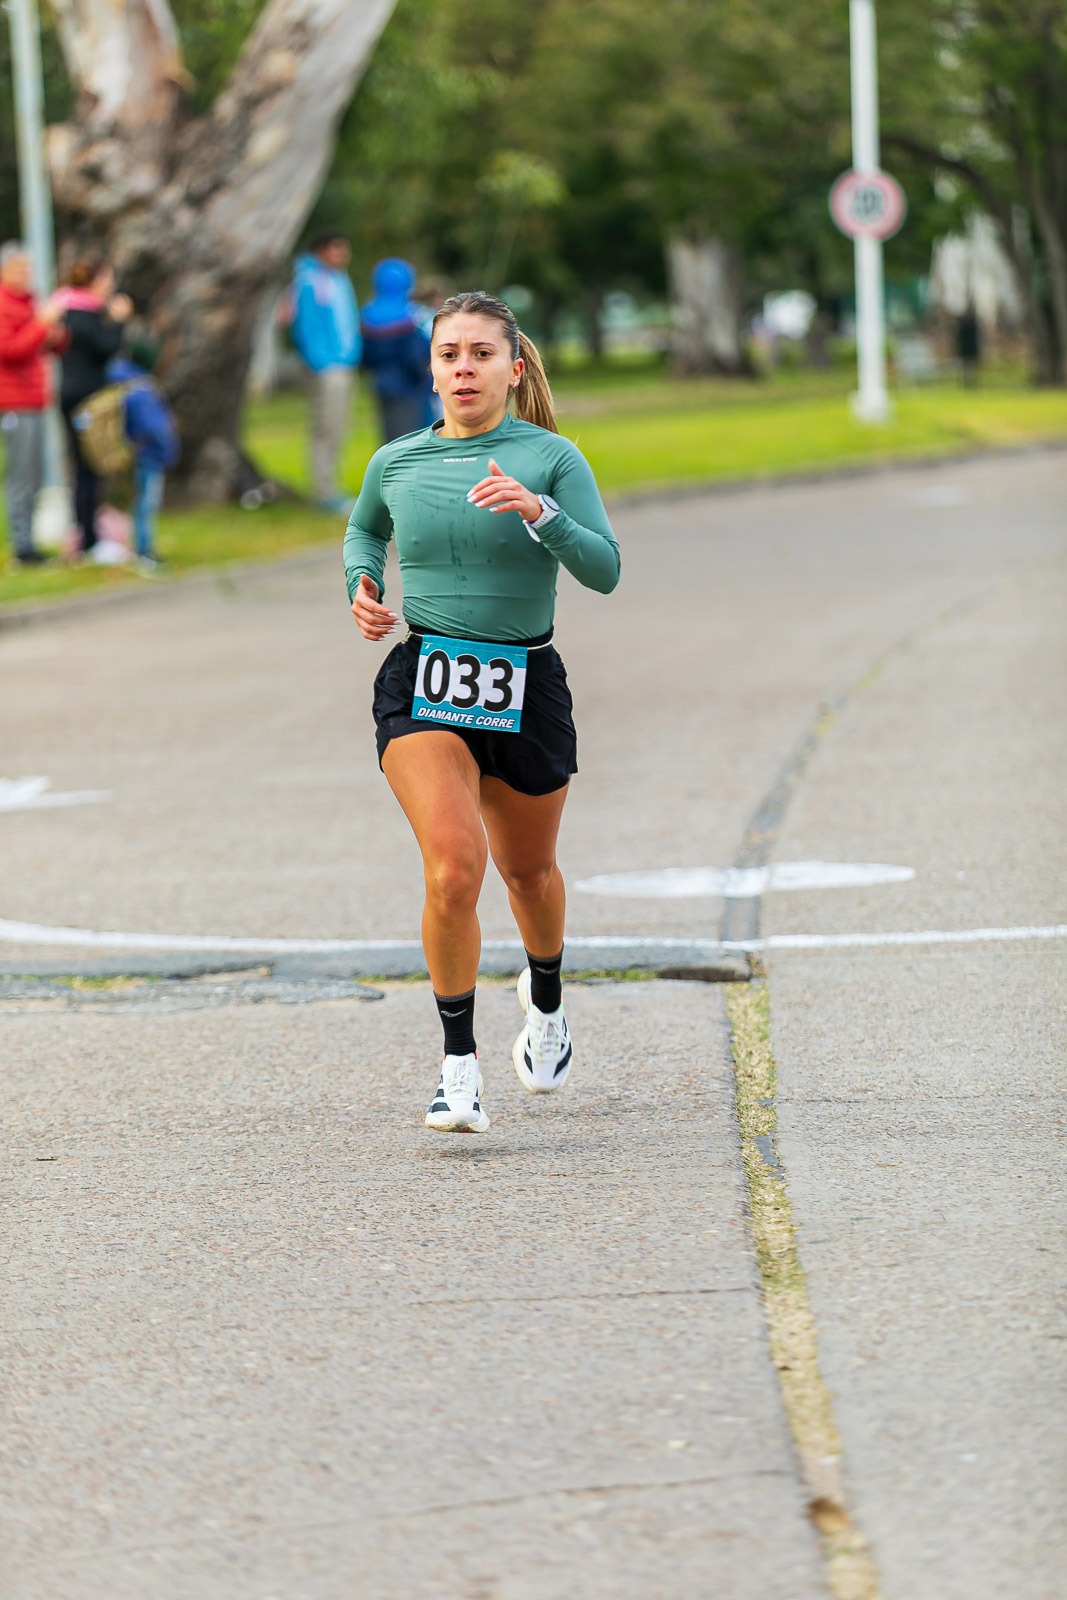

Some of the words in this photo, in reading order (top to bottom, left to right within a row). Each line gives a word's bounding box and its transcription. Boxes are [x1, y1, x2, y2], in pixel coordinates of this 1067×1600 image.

[423, 649, 513, 713] 033
[417, 707, 474, 724] DIAMANTE
[476, 715, 515, 728] CORRE
